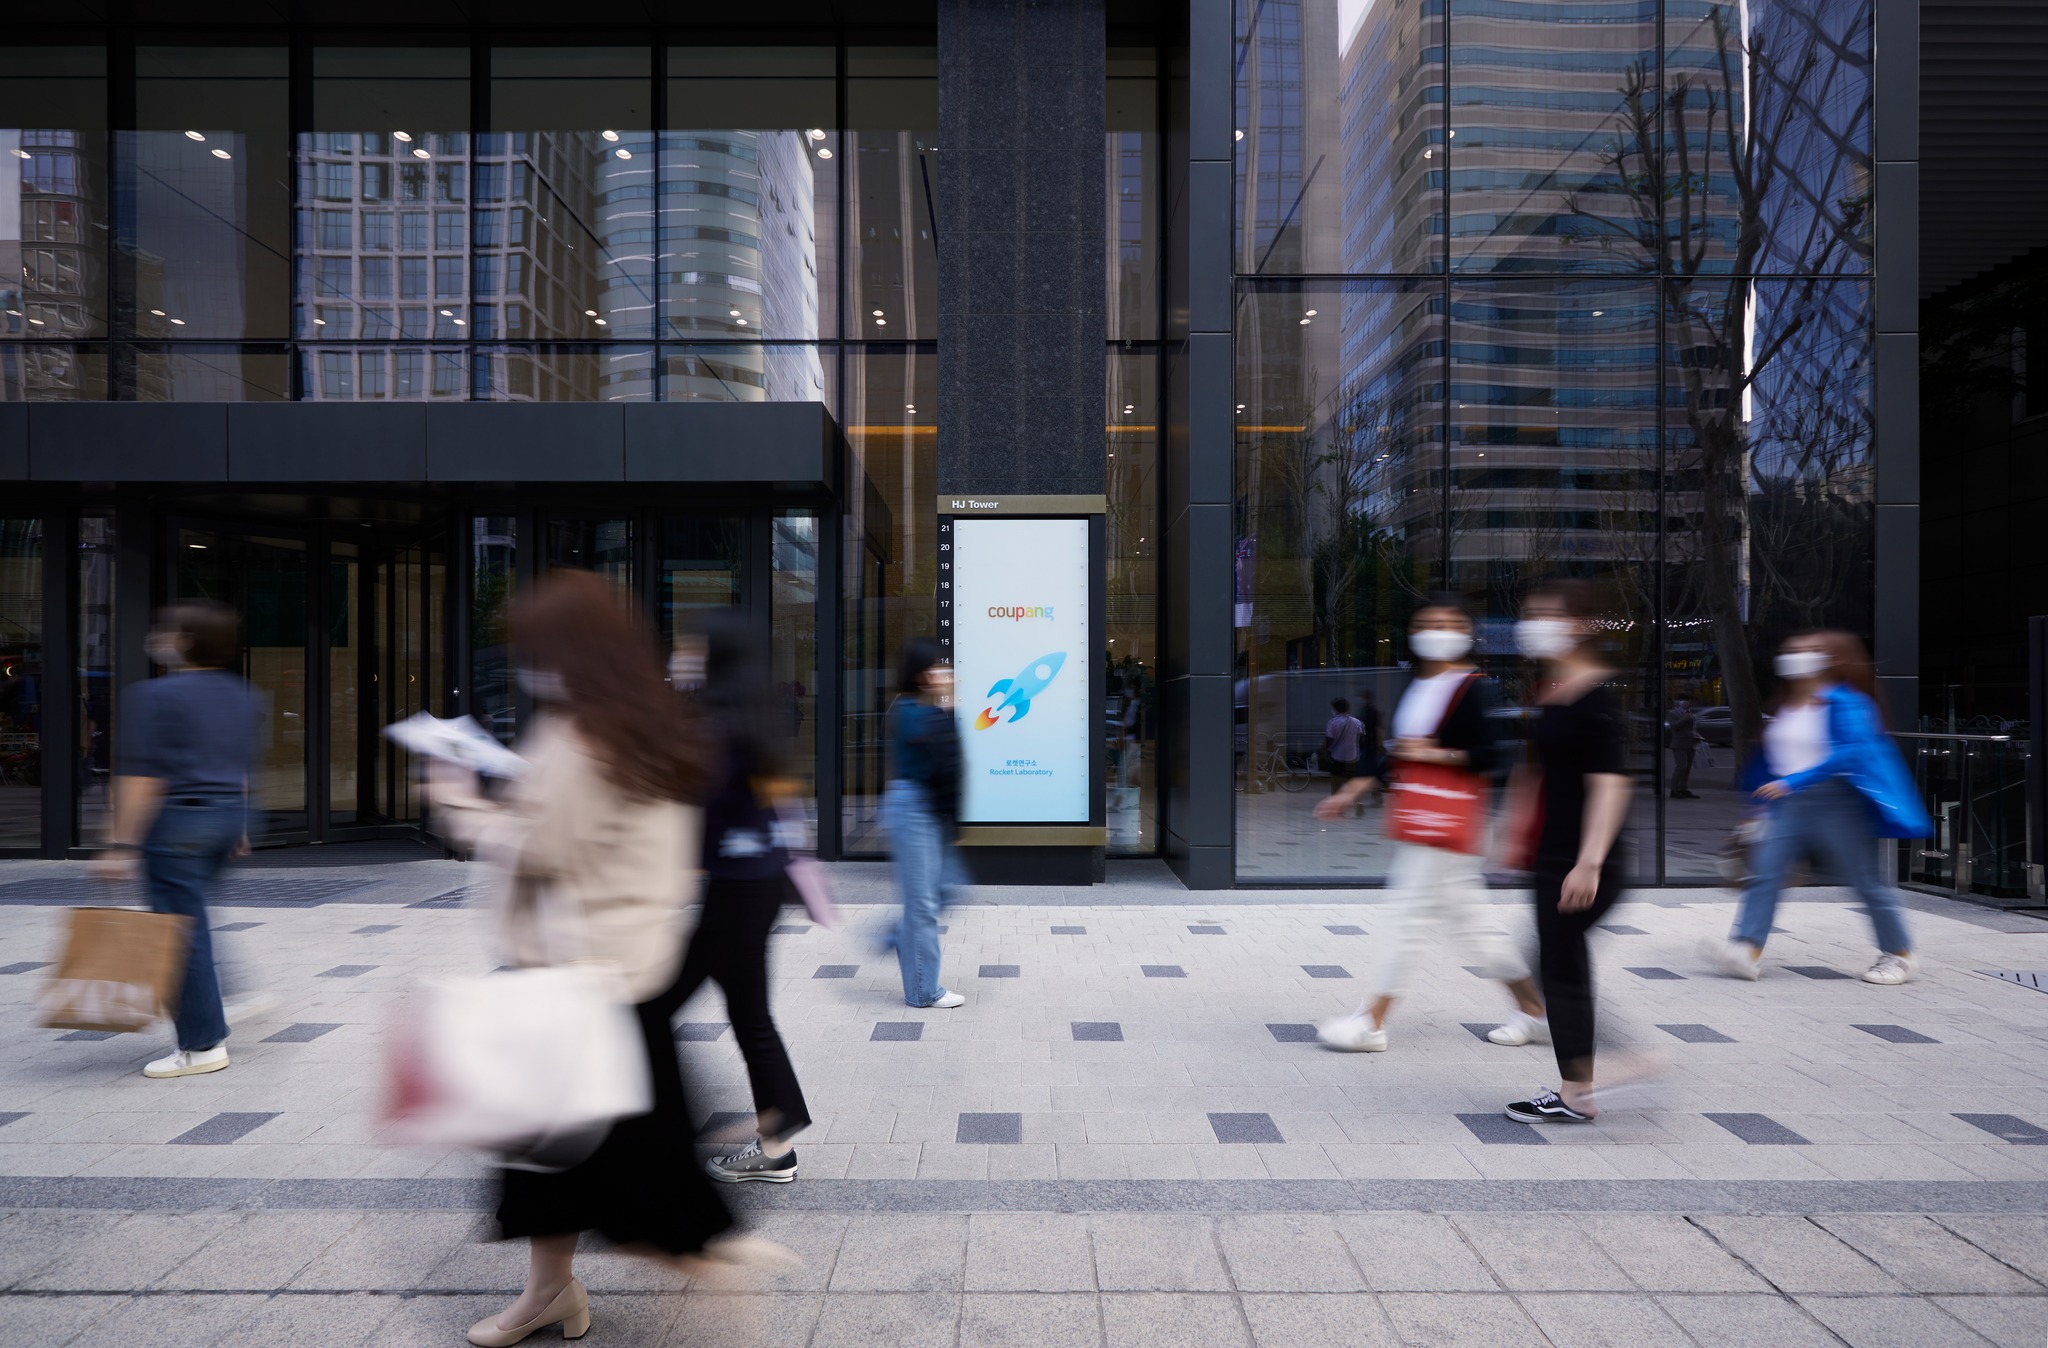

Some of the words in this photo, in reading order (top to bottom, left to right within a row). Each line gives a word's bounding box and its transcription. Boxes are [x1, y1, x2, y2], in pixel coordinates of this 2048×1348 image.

[952, 500, 966, 508] HJ
[968, 500, 999, 508] Tower
[988, 606, 1054, 622] coupang
[1015, 768, 1053, 776] Laboratory
